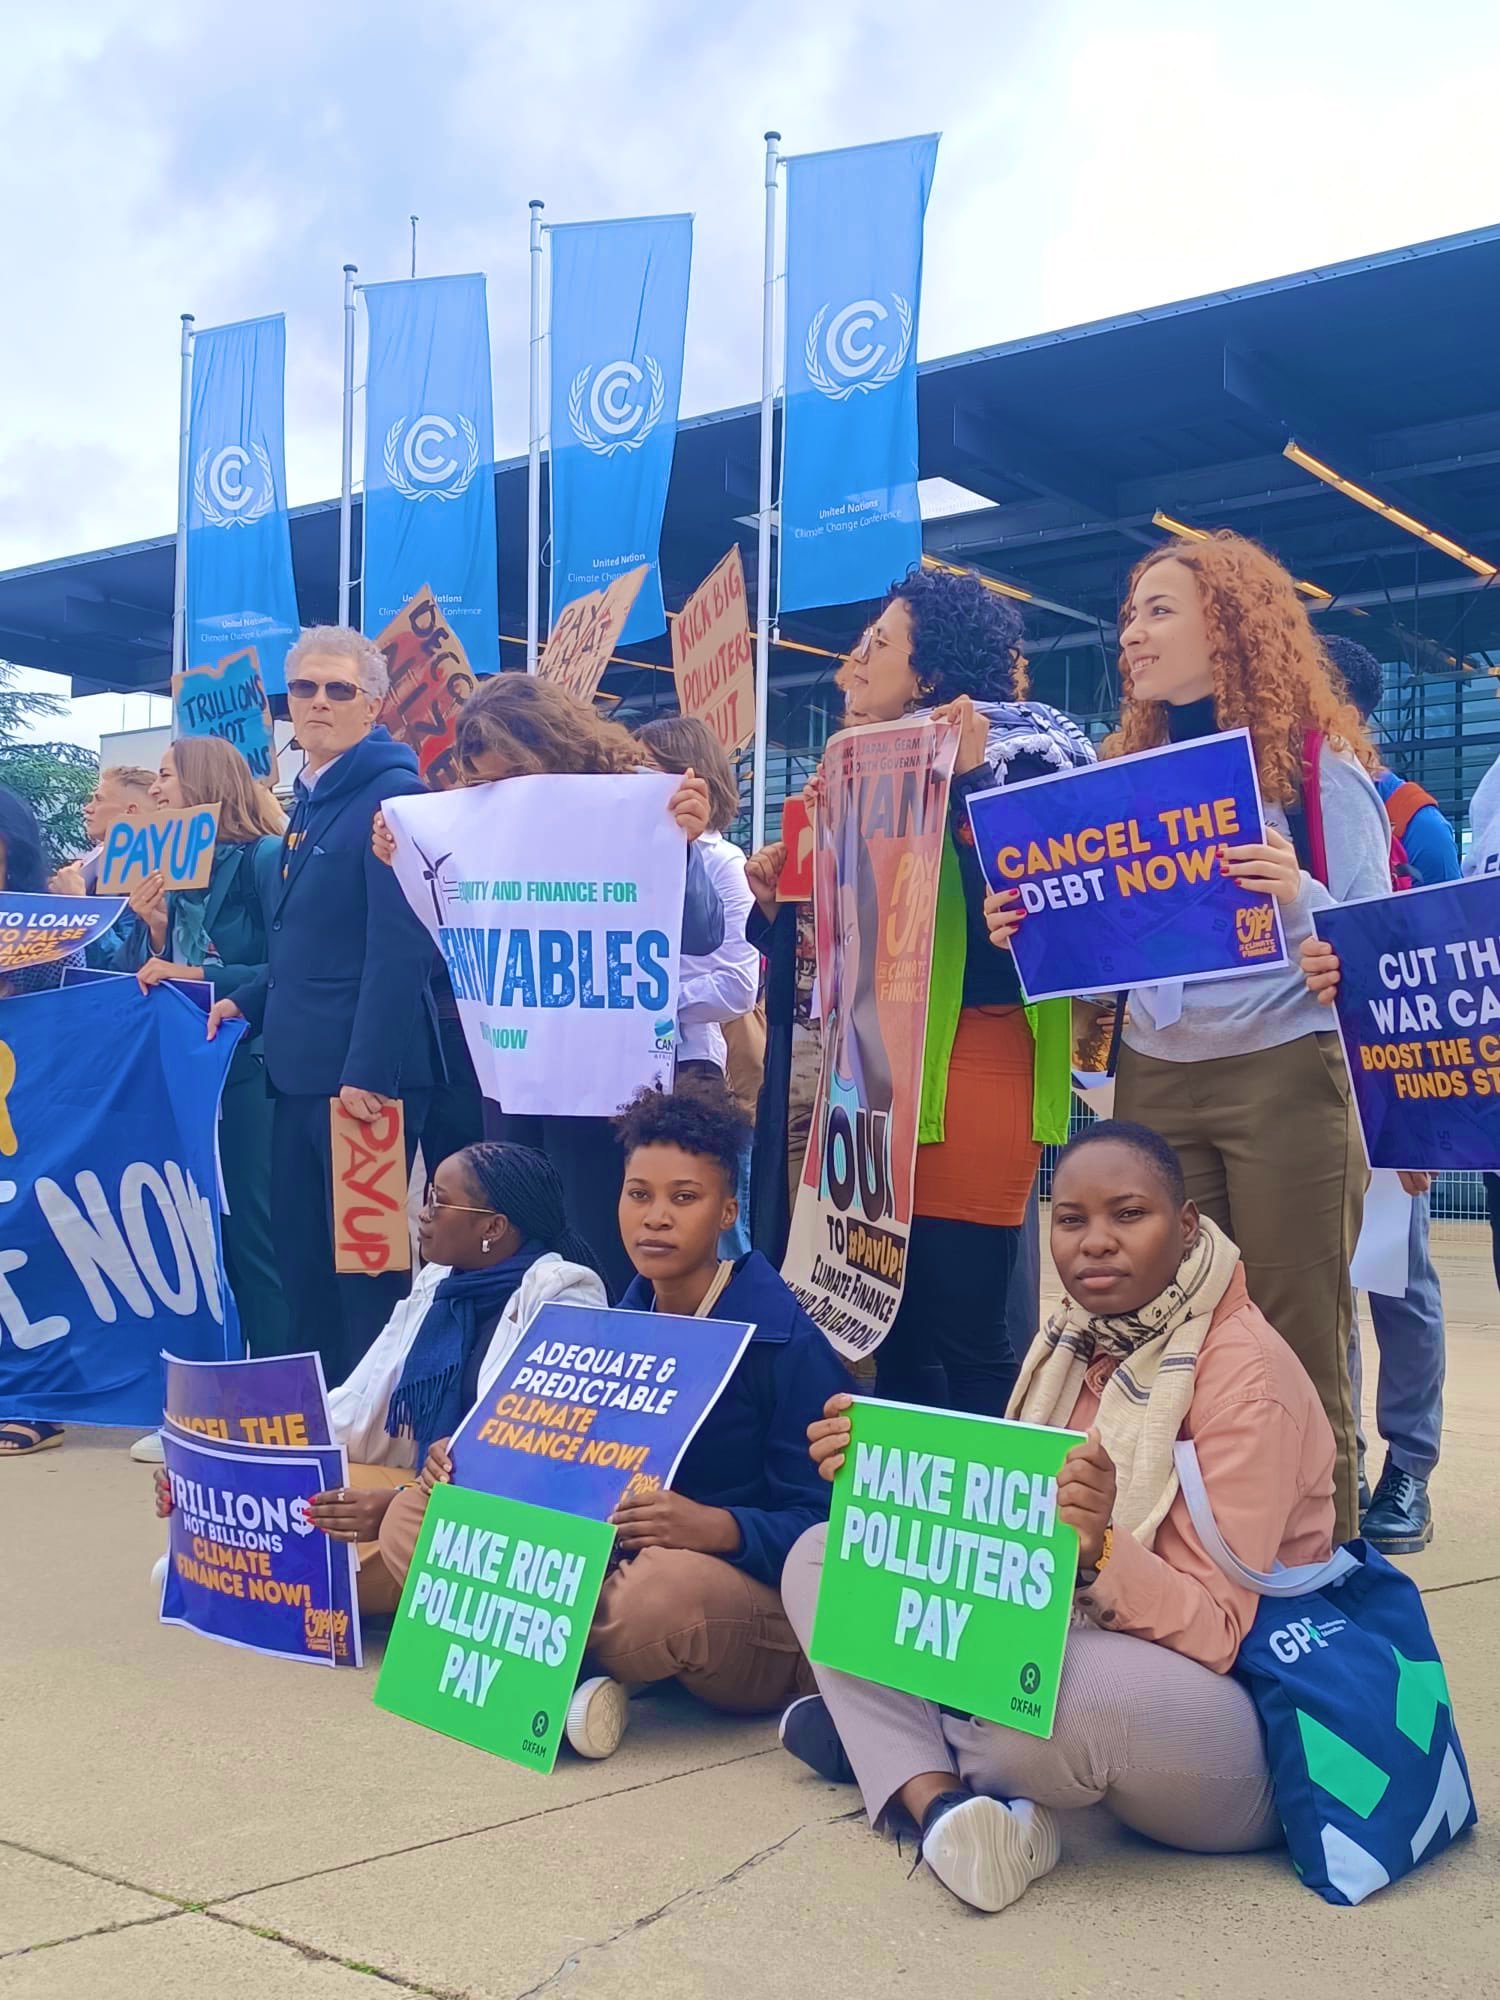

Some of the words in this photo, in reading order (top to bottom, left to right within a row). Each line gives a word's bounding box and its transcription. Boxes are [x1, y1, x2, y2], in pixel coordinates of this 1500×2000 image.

[794, 526, 825, 539] Climate
[826, 519, 859, 532] Change
[859, 510, 902, 527] Conference
[819, 504, 846, 519] United
[847, 500, 879, 513] Nations
[567, 572, 600, 583] Climate
[592, 556, 620, 568] United
[432, 595, 463, 603] ations
[678, 596, 711, 662] KICK
[713, 562, 742, 619] BIG
[683, 626, 751, 714] POLLUTERS
[182, 674, 267, 729] TRILLIONS
[997, 817, 1151, 879] CANCEL
[1158, 797, 1240, 846] THE
[491, 881, 522, 901] AND
[526, 881, 598, 903] FINANCE
[602, 882, 638, 903] FOR
[1019, 868, 1105, 915] DEBT
[23, 928, 87, 943] FALSE
[26, 912, 100, 928] LOANS
[1378, 946, 1438, 991] CUT
[1445, 936, 1500, 981] TH
[880, 980, 926, 1003] FINANCE
[1368, 994, 1443, 1036] WAR
[1447, 984, 1500, 1028] CA
[491, 1028, 528, 1050] NOW
[1359, 1042, 1424, 1071] BOOST
[1425, 1037, 1475, 1067] THE
[1395, 1070, 1468, 1100] FUNDS
[1473, 1065, 1500, 1094] ST
[826, 1104, 887, 1223] OU
[35, 1159, 224, 1326] NOW
[826, 1214, 845, 1255] TO
[810, 1253, 853, 1301] CLIMATE
[848, 1272, 897, 1325] FINANCE
[809, 1295, 882, 1352] OBLIGATION!
[525, 1340, 656, 1382] ADEQUATE
[655, 1356, 677, 1383] &
[495, 1393, 598, 1433] CLIMATE
[510, 1367, 679, 1416] PREDICTABLE
[240, 1413, 309, 1446] THE
[477, 1418, 584, 1462] FINANCE
[580, 1439, 651, 1472] NOW!
[852, 1441, 956, 1516] MAKE
[962, 1461, 1059, 1538] RICH
[183, 1516, 206, 1537] NOT
[208, 1521, 284, 1553] BILLIONS
[193, 1536, 272, 1577] CLIMATE
[839, 1504, 1056, 1610] POLLUTERS
[177, 1553, 244, 1599] FINANCE
[249, 1578, 312, 1609] NOW!
[426, 1517, 510, 1585] MAKE
[505, 1538, 587, 1608] RICH
[407, 1570, 573, 1668] POLLUTERS
[893, 1586, 974, 1662] PAY
[437, 1642, 503, 1708] PAY
[1010, 1696, 1042, 1719] OXFAM
[521, 1738, 547, 1758] OXFAM
